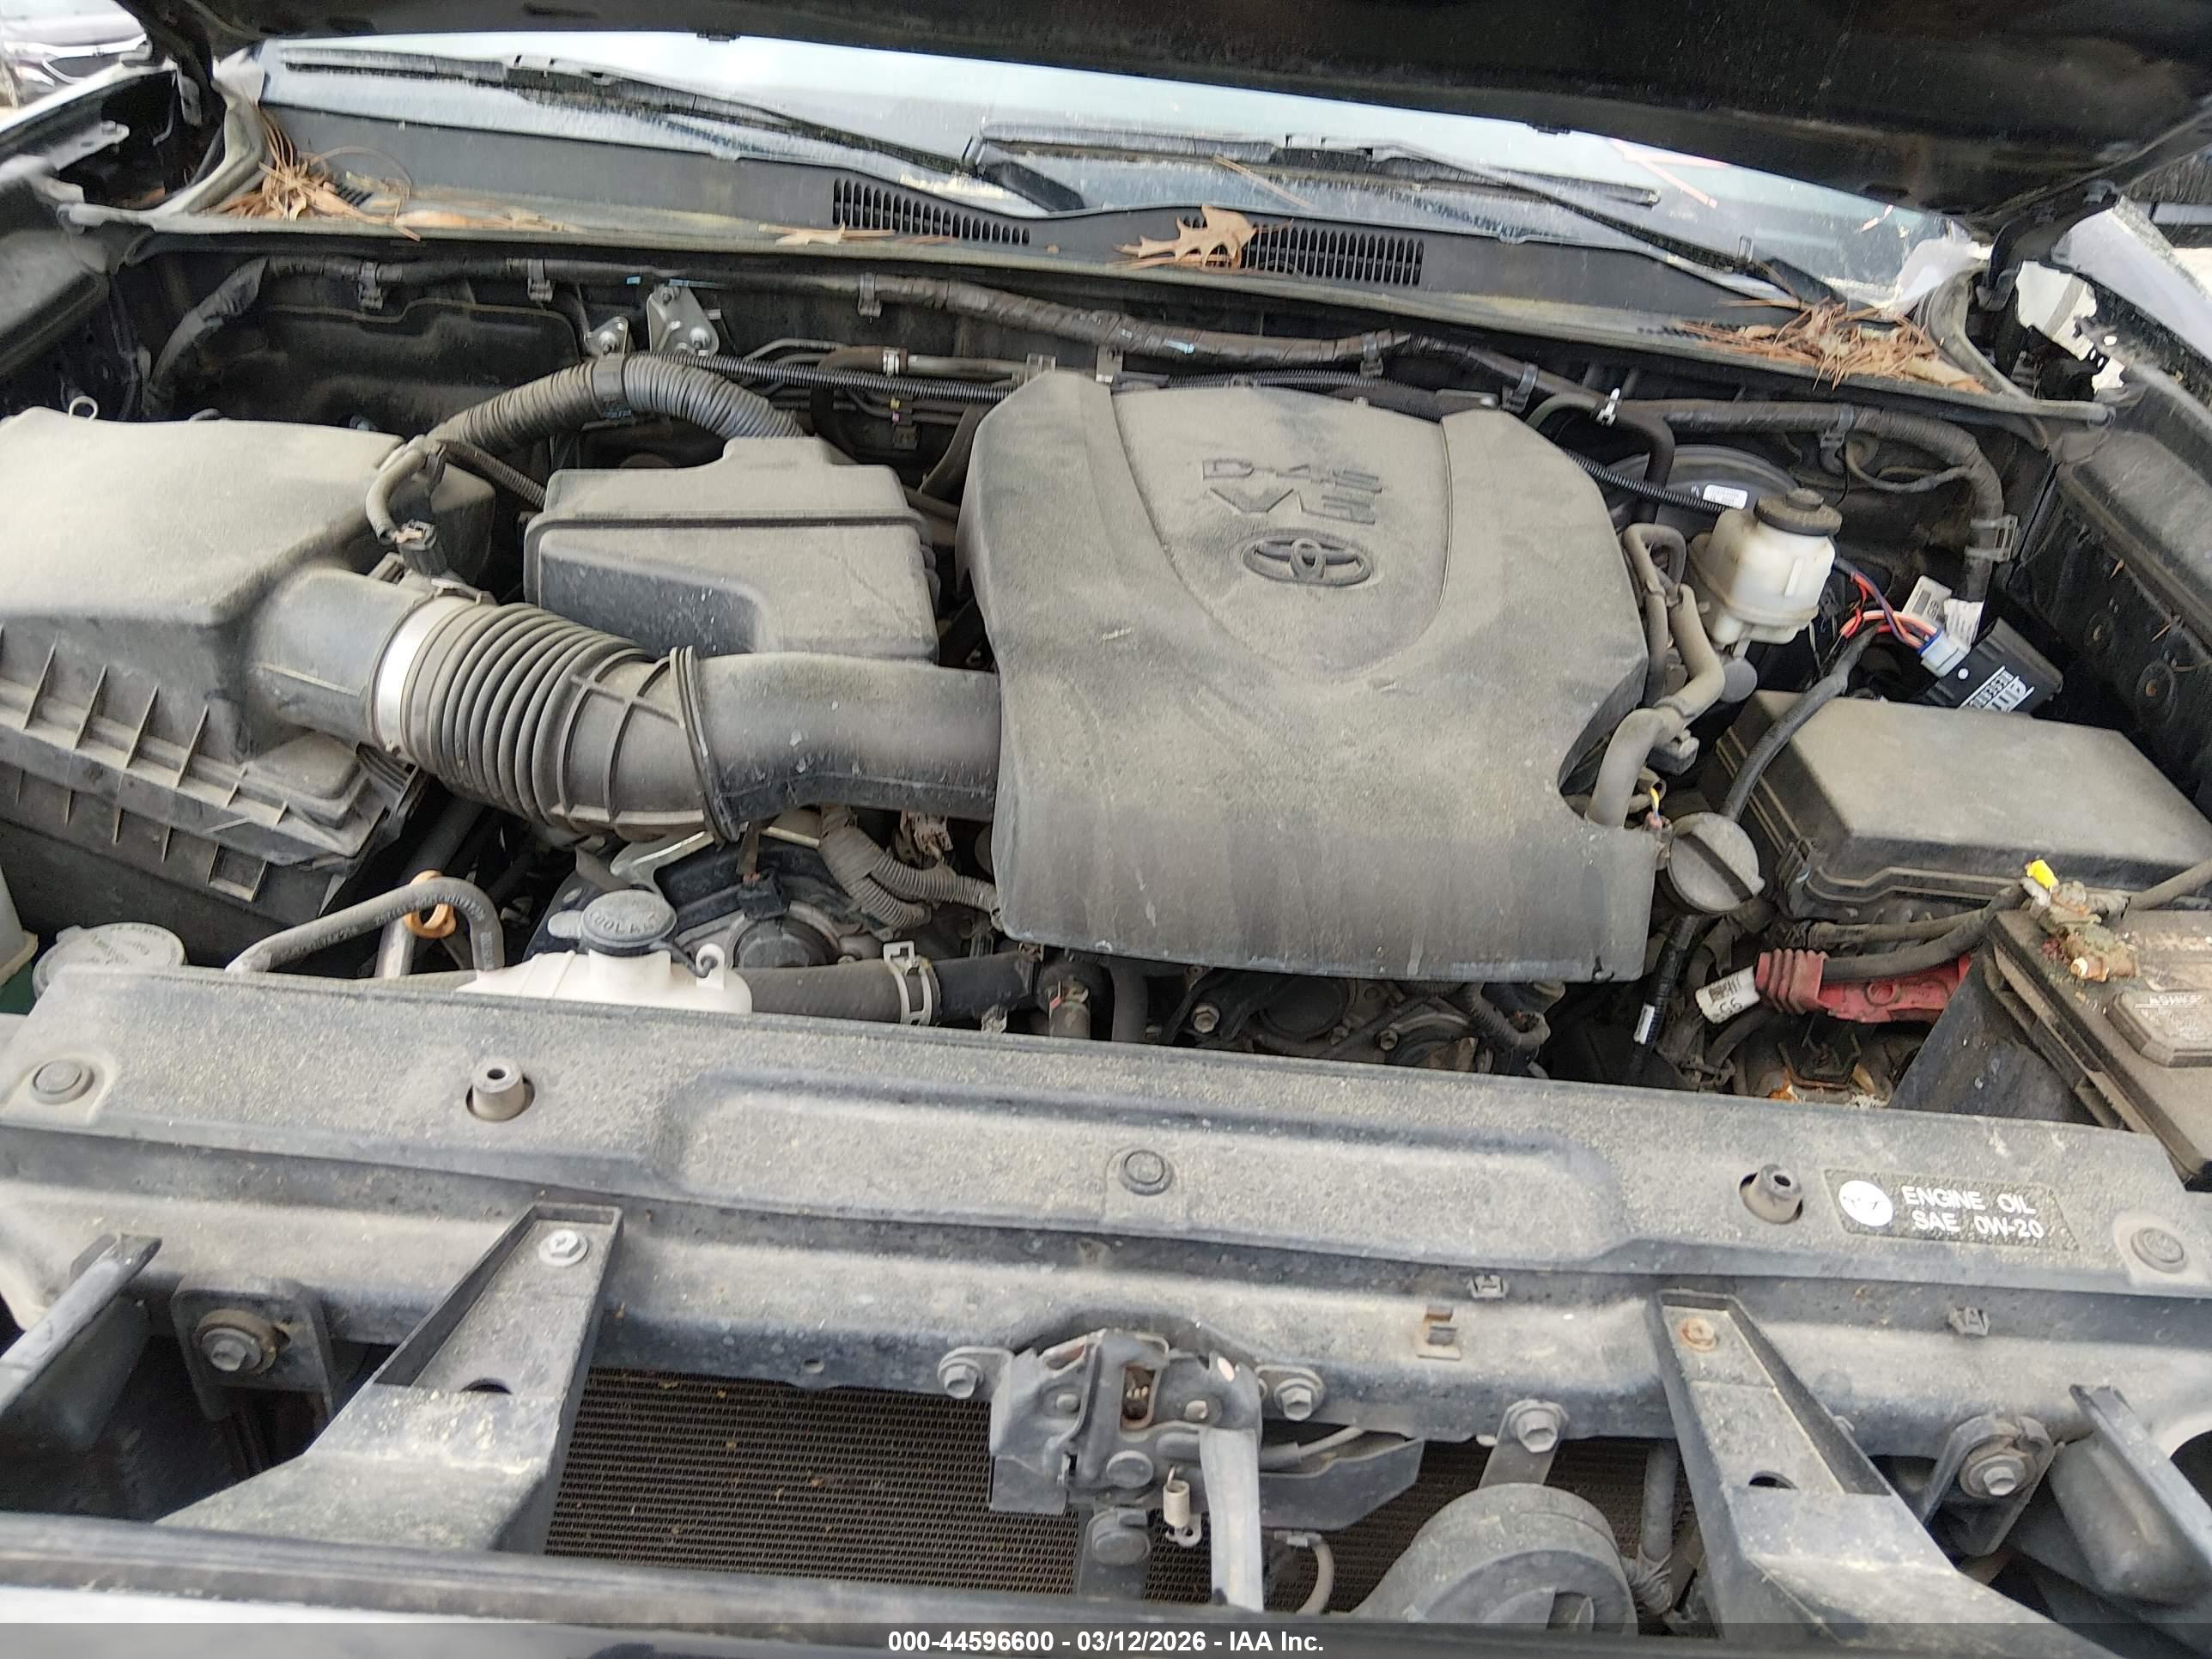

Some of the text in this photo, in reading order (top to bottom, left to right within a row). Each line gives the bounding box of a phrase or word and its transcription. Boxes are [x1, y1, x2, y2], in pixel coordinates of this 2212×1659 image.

[1901, 1185, 2037, 1215] ENGINE OIL
[1911, 1210, 2045, 1239] SAE 0W-20
